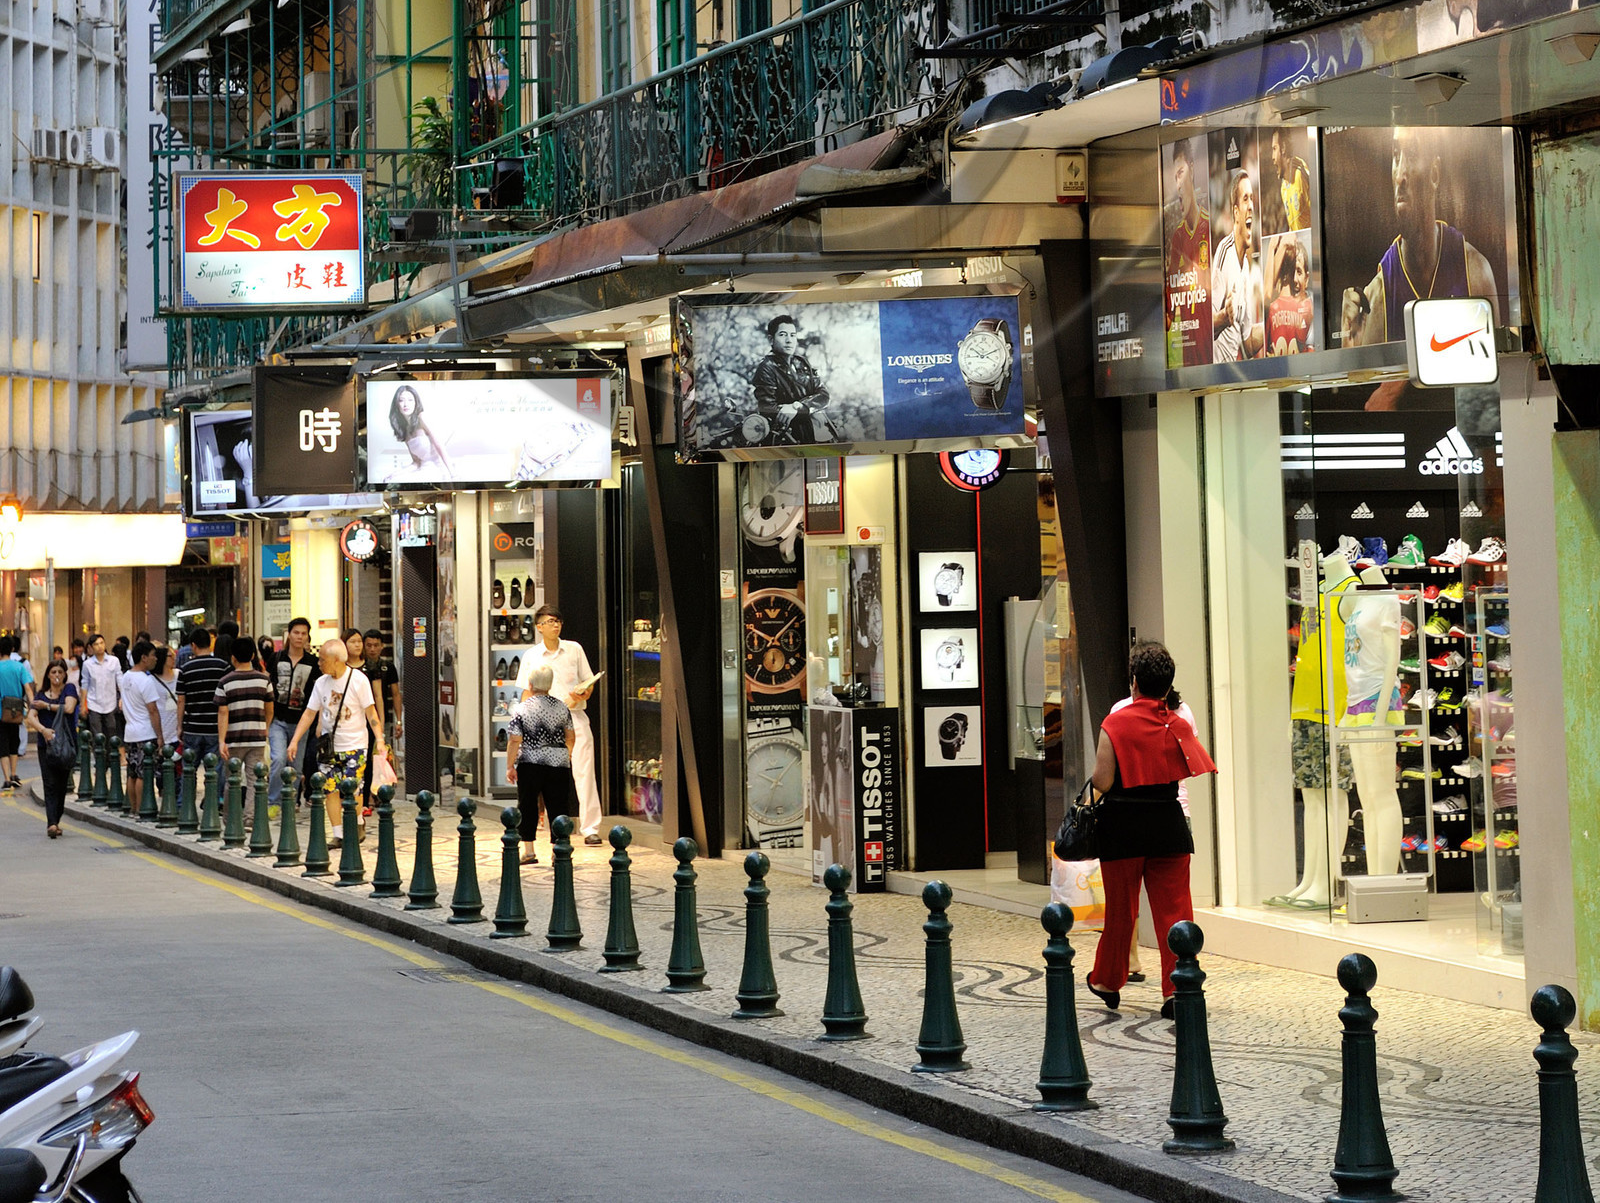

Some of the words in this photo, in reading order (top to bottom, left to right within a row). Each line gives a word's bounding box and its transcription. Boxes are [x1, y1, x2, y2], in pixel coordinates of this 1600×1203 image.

[198, 184, 342, 250] 大方
[287, 261, 348, 290] 皮鞋
[1169, 269, 1198, 288] unleash
[1170, 291, 1187, 311] your
[1187, 286, 1207, 312] pride
[887, 354, 953, 367] LONGINES
[299, 407, 342, 453] 時
[1418, 457, 1484, 475] adidas
[806, 480, 840, 505] TISSOT
[883, 725, 892, 748] 1853
[861, 726, 883, 839] TISSOT
[884, 753, 893, 786] SINCE
[885, 791, 894, 841] WATCHES
